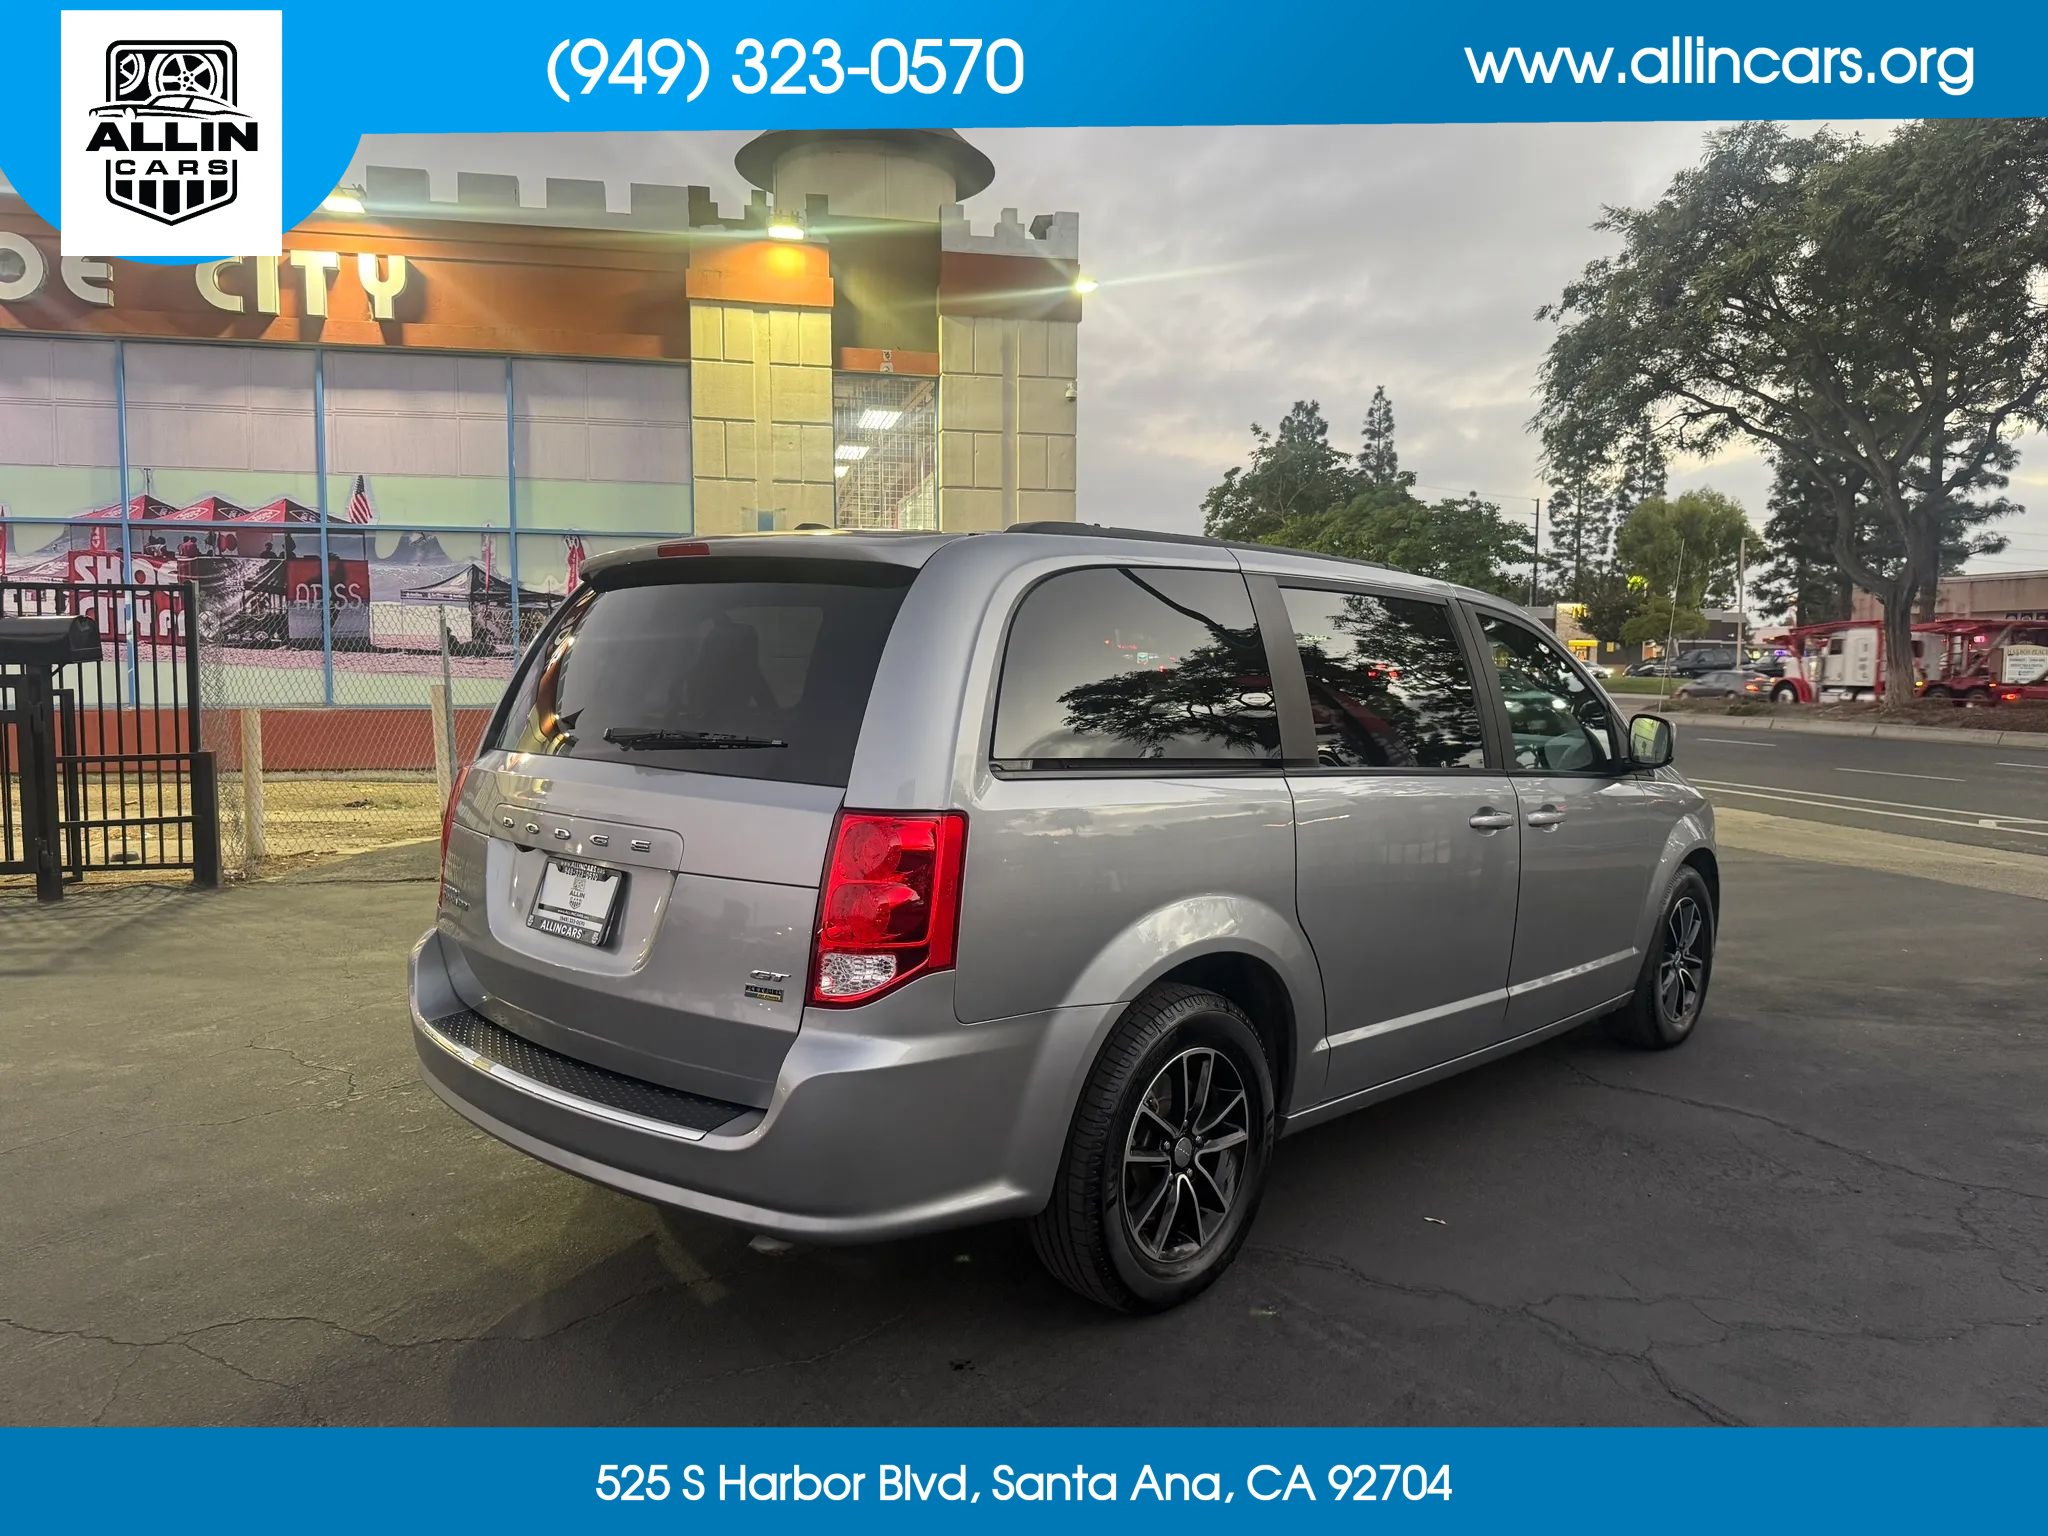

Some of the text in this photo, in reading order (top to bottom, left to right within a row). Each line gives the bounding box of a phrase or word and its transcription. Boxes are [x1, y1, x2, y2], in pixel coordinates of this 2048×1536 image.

[195, 249, 407, 319] CITY
[503, 816, 651, 853] DODGE
[540, 919, 583, 940] ALLINCARS
[750, 969, 791, 982] GT
